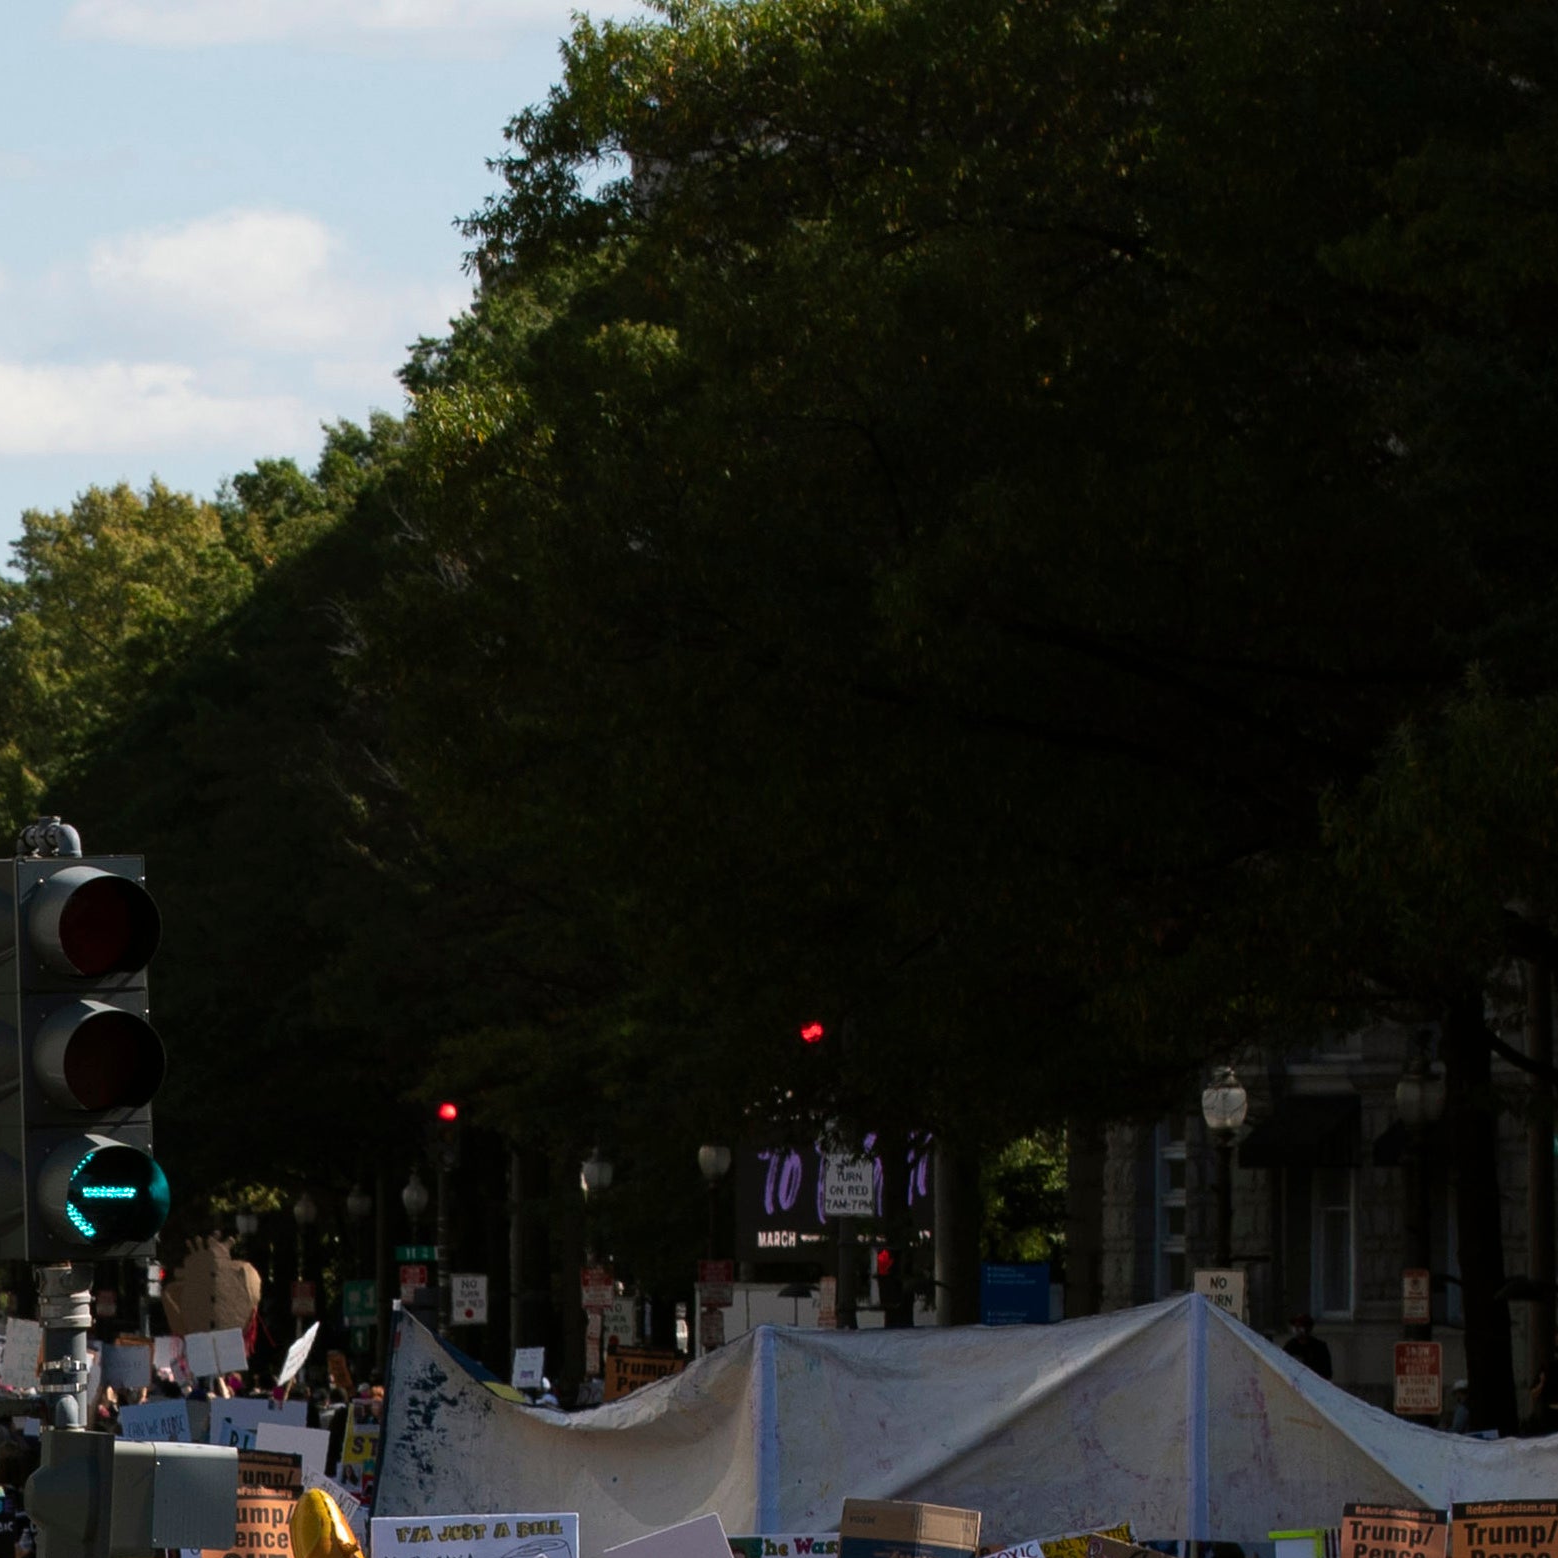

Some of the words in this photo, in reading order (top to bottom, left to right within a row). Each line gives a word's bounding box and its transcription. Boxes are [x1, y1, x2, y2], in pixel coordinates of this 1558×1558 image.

[837, 1172, 862, 1181] TURN
[830, 1185, 845, 1195] ON
[849, 1185, 868, 1195] RED
[758, 1231, 796, 1246] MARCH
[461, 1280, 478, 1289] NO
[1350, 1521, 1434, 1547] Trump/
